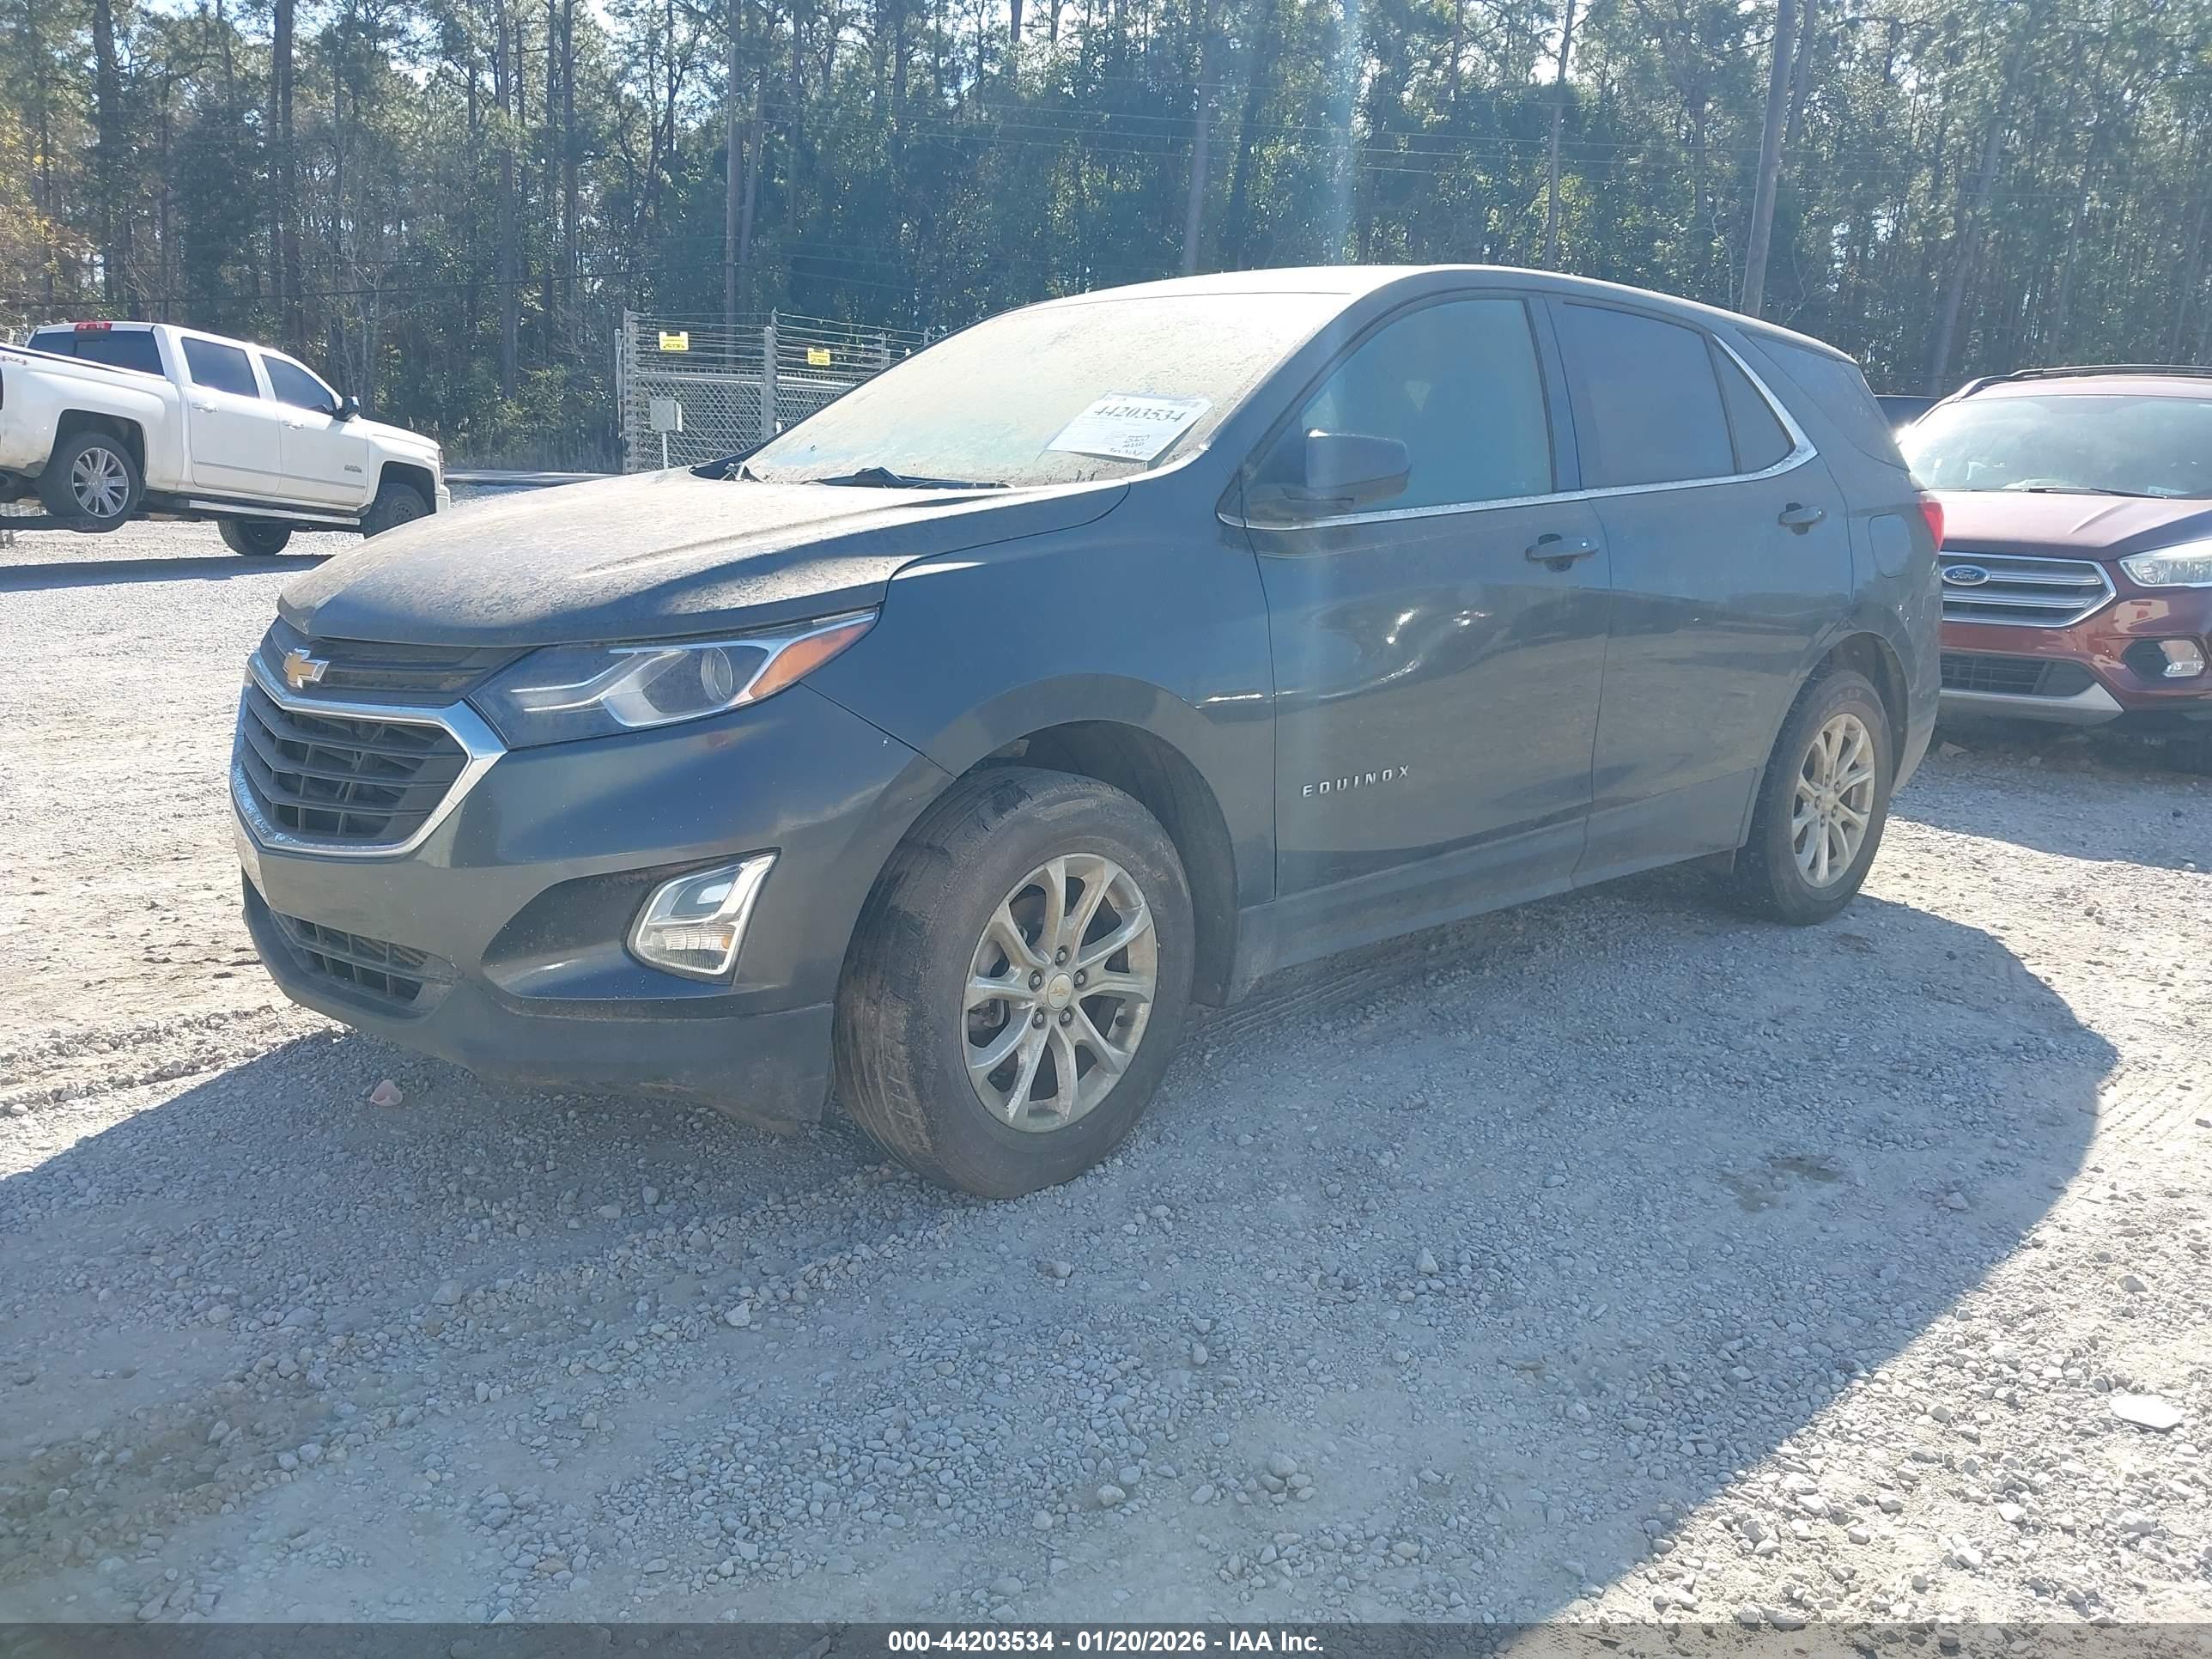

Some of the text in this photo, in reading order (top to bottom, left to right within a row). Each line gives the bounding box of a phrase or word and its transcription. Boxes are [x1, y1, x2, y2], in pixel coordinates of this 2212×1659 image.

[1093, 405, 1188, 422] 44203534
[1952, 568, 1978, 580] Ford
[1302, 764, 1409, 798] EQUINOX
